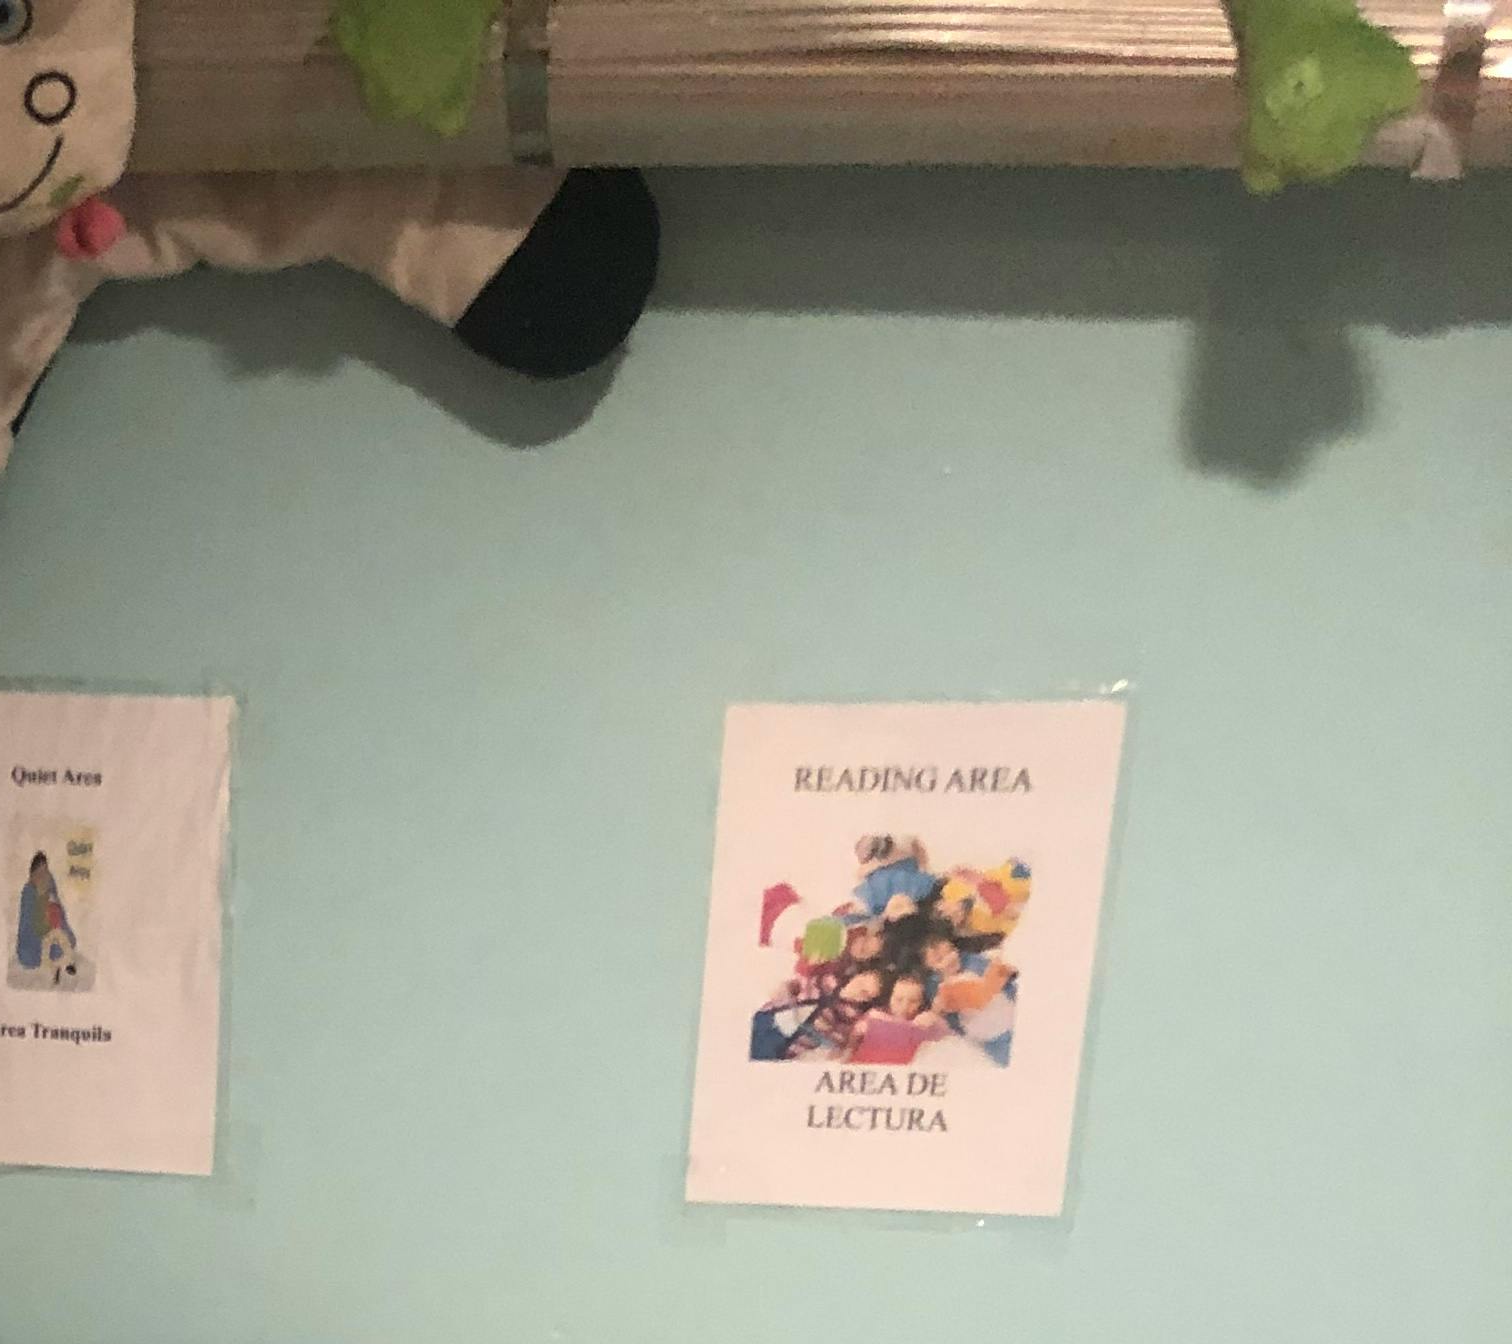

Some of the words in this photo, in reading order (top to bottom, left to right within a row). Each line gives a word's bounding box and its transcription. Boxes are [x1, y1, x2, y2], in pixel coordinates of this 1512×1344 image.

[11, 766, 57, 788] Quiet
[64, 768, 102, 787] Area
[794, 766, 937, 793] READING
[944, 769, 1032, 793] AREA
[814, 1071, 898, 1096] AREA
[906, 1072, 947, 1096] DE
[807, 1105, 947, 1132] LECTURA
